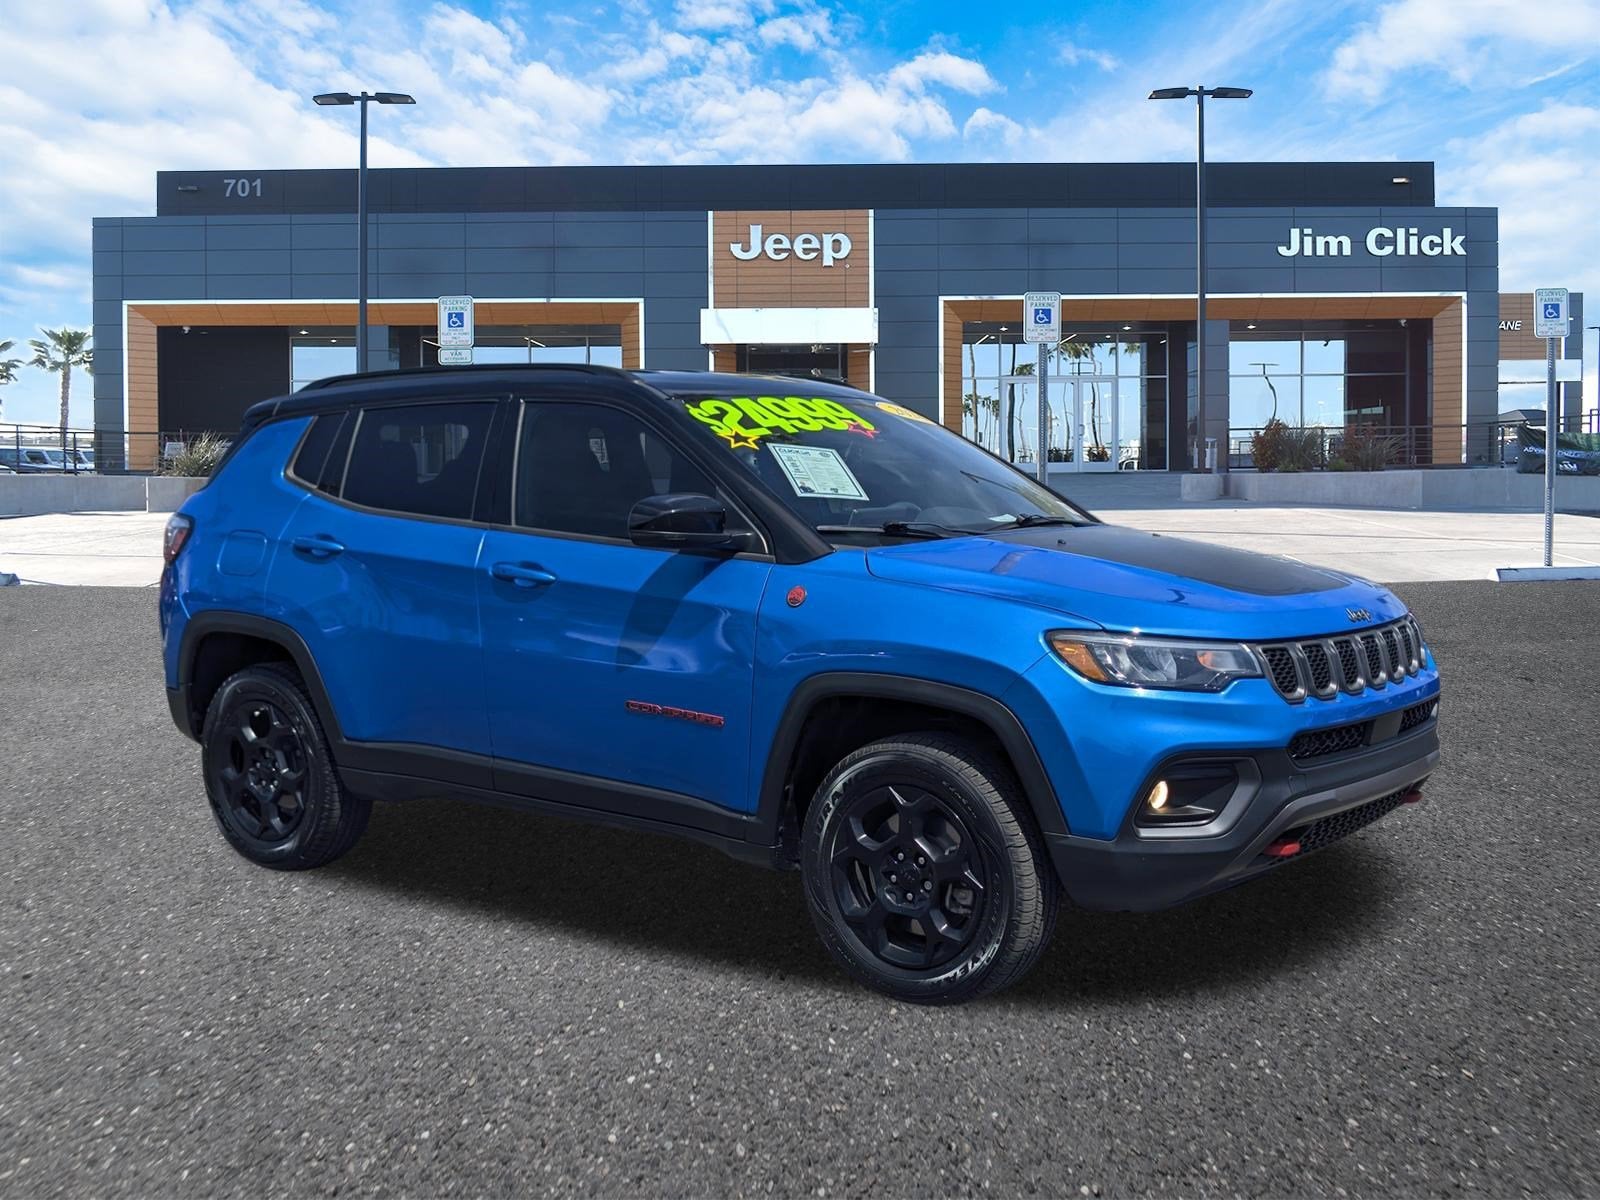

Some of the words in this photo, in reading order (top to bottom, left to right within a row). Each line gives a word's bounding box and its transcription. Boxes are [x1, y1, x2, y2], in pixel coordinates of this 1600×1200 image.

[223, 178, 262, 198] 701
[729, 223, 853, 267] Jeep
[1277, 227, 1351, 257] Jim
[1365, 226, 1468, 257] Click
